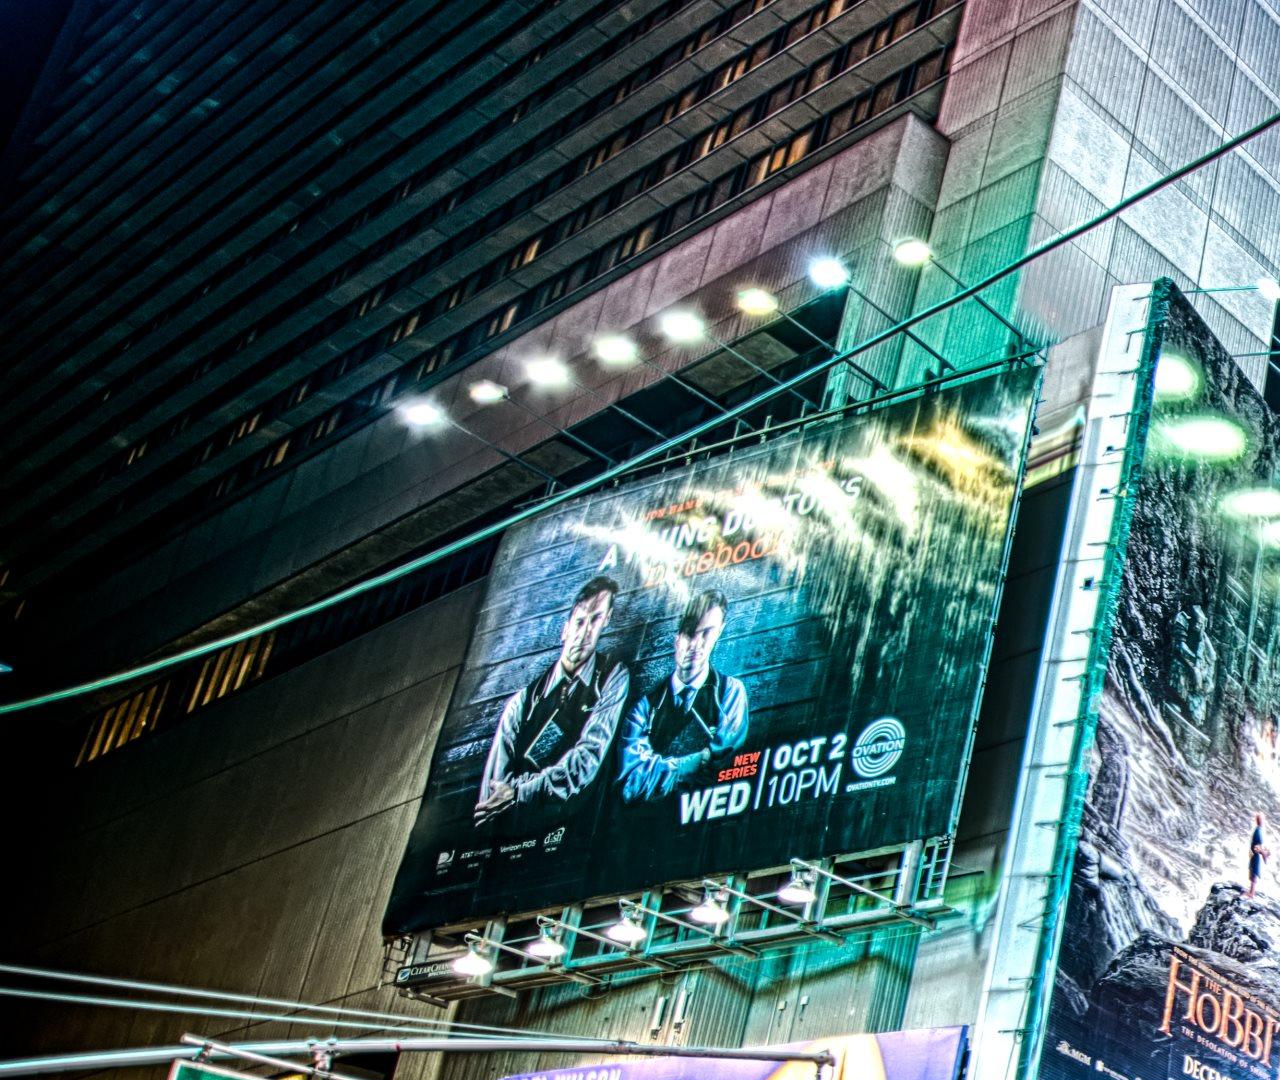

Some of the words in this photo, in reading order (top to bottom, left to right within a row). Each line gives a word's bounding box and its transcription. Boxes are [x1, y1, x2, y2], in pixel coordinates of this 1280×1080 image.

[733, 751, 761, 767] NEW
[772, 736, 828, 770] OCT
[828, 732, 848, 760] 2
[852, 737, 905, 759] OVATION
[718, 764, 757, 782] SERIES
[767, 762, 843, 807] 10PM
[680, 780, 751, 824] WED
[1204, 977, 1223, 995] THE
